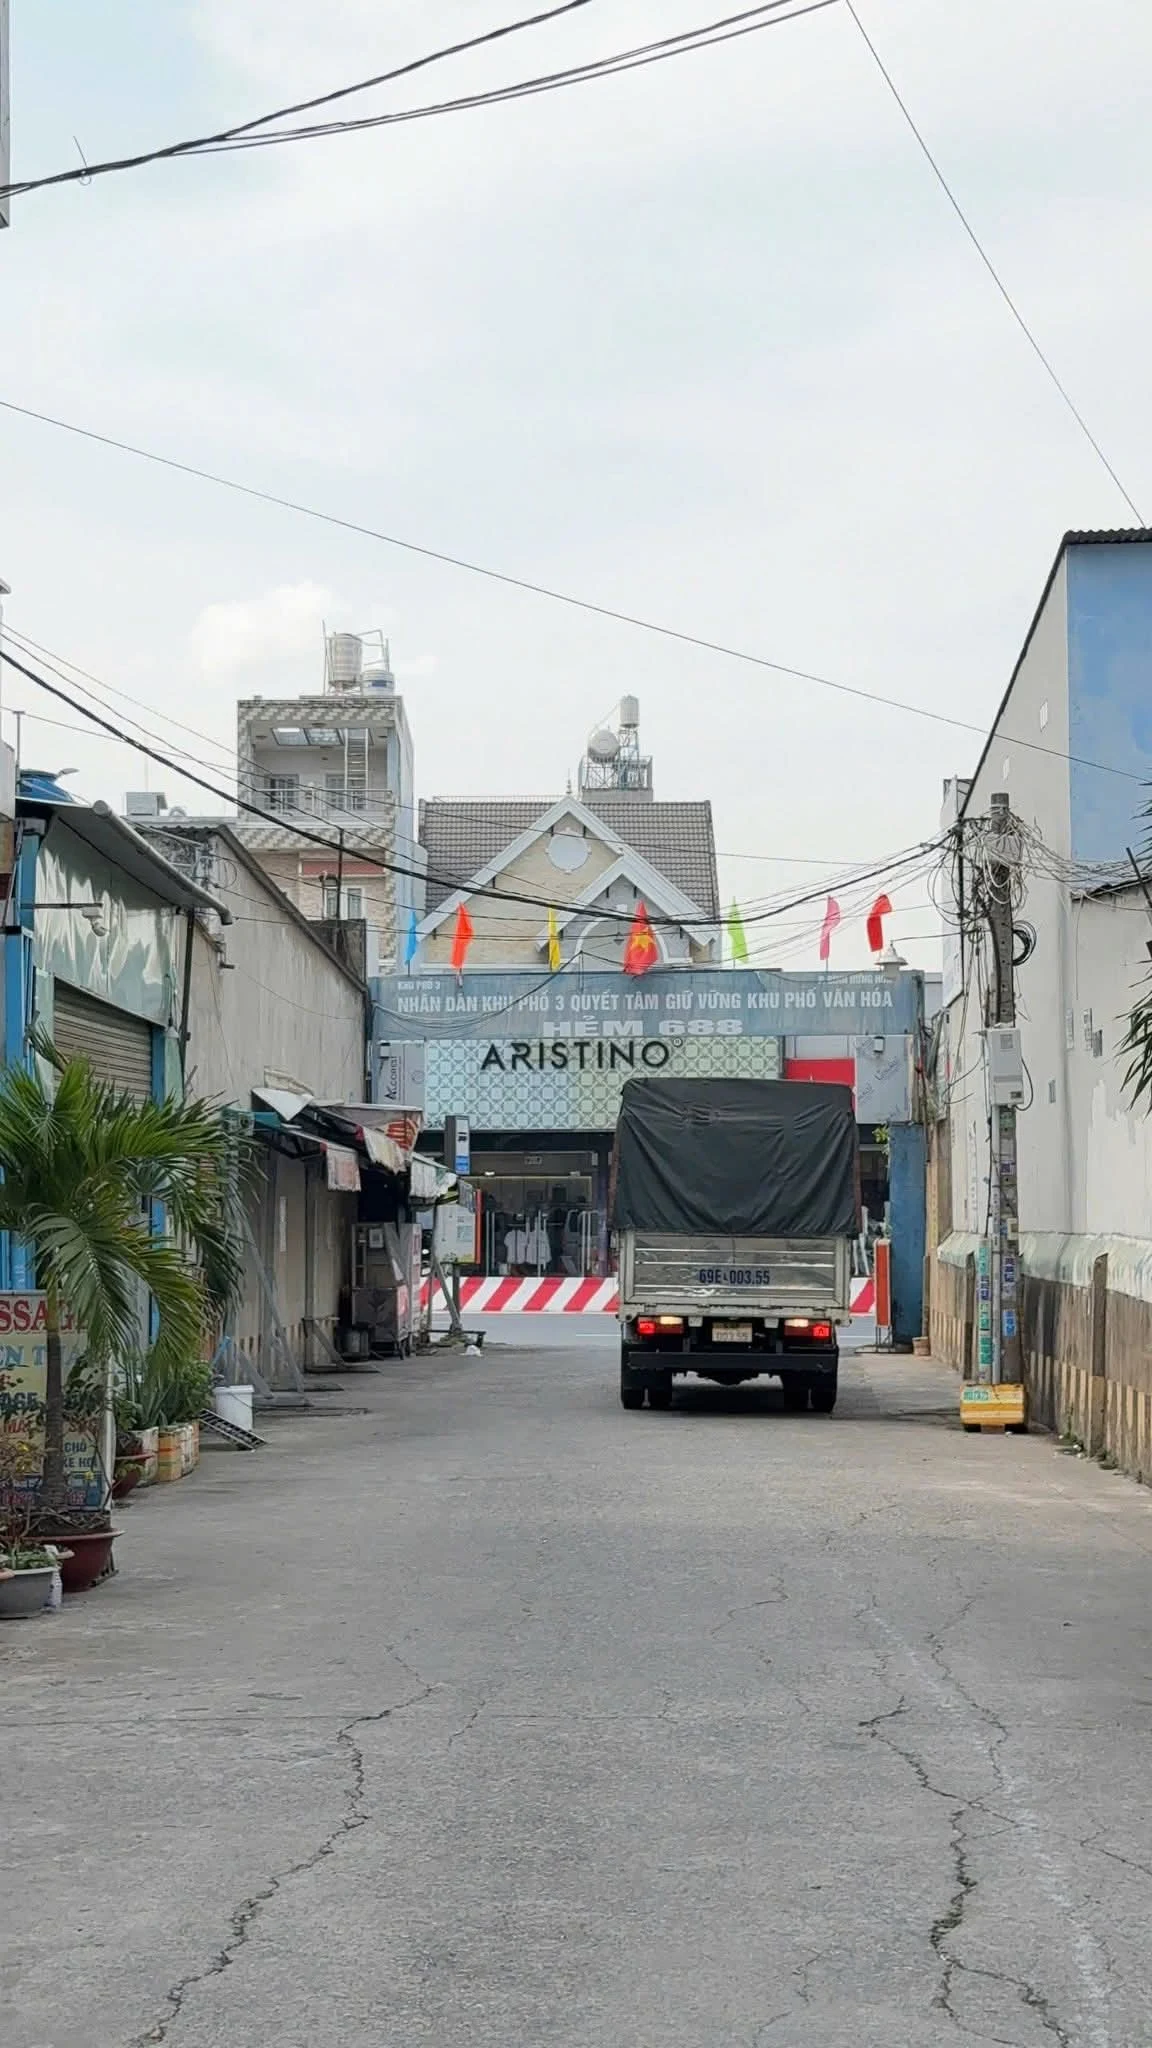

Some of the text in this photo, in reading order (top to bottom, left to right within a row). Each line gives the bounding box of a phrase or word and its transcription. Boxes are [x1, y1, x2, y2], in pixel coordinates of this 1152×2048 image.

[482, 996, 513, 1013] KHU
[518, 990, 549, 1012] PHỐ
[555, 994, 565, 1011] 3
[571, 989, 619, 1011] QUYẾT
[625, 991, 659, 1011] TÂM
[665, 990, 693, 1010] GIỮ
[698, 989, 741, 1010] VỮNG
[748, 992, 780, 1009] KHU
[784, 987, 817, 1009] PHỐ
[822, 988, 856, 1008] VĂN
[860, 987, 894, 1008] HÓA
[543, 1015, 744, 1037] HẺM 688
[480, 1040, 669, 1071] ARISTINO
